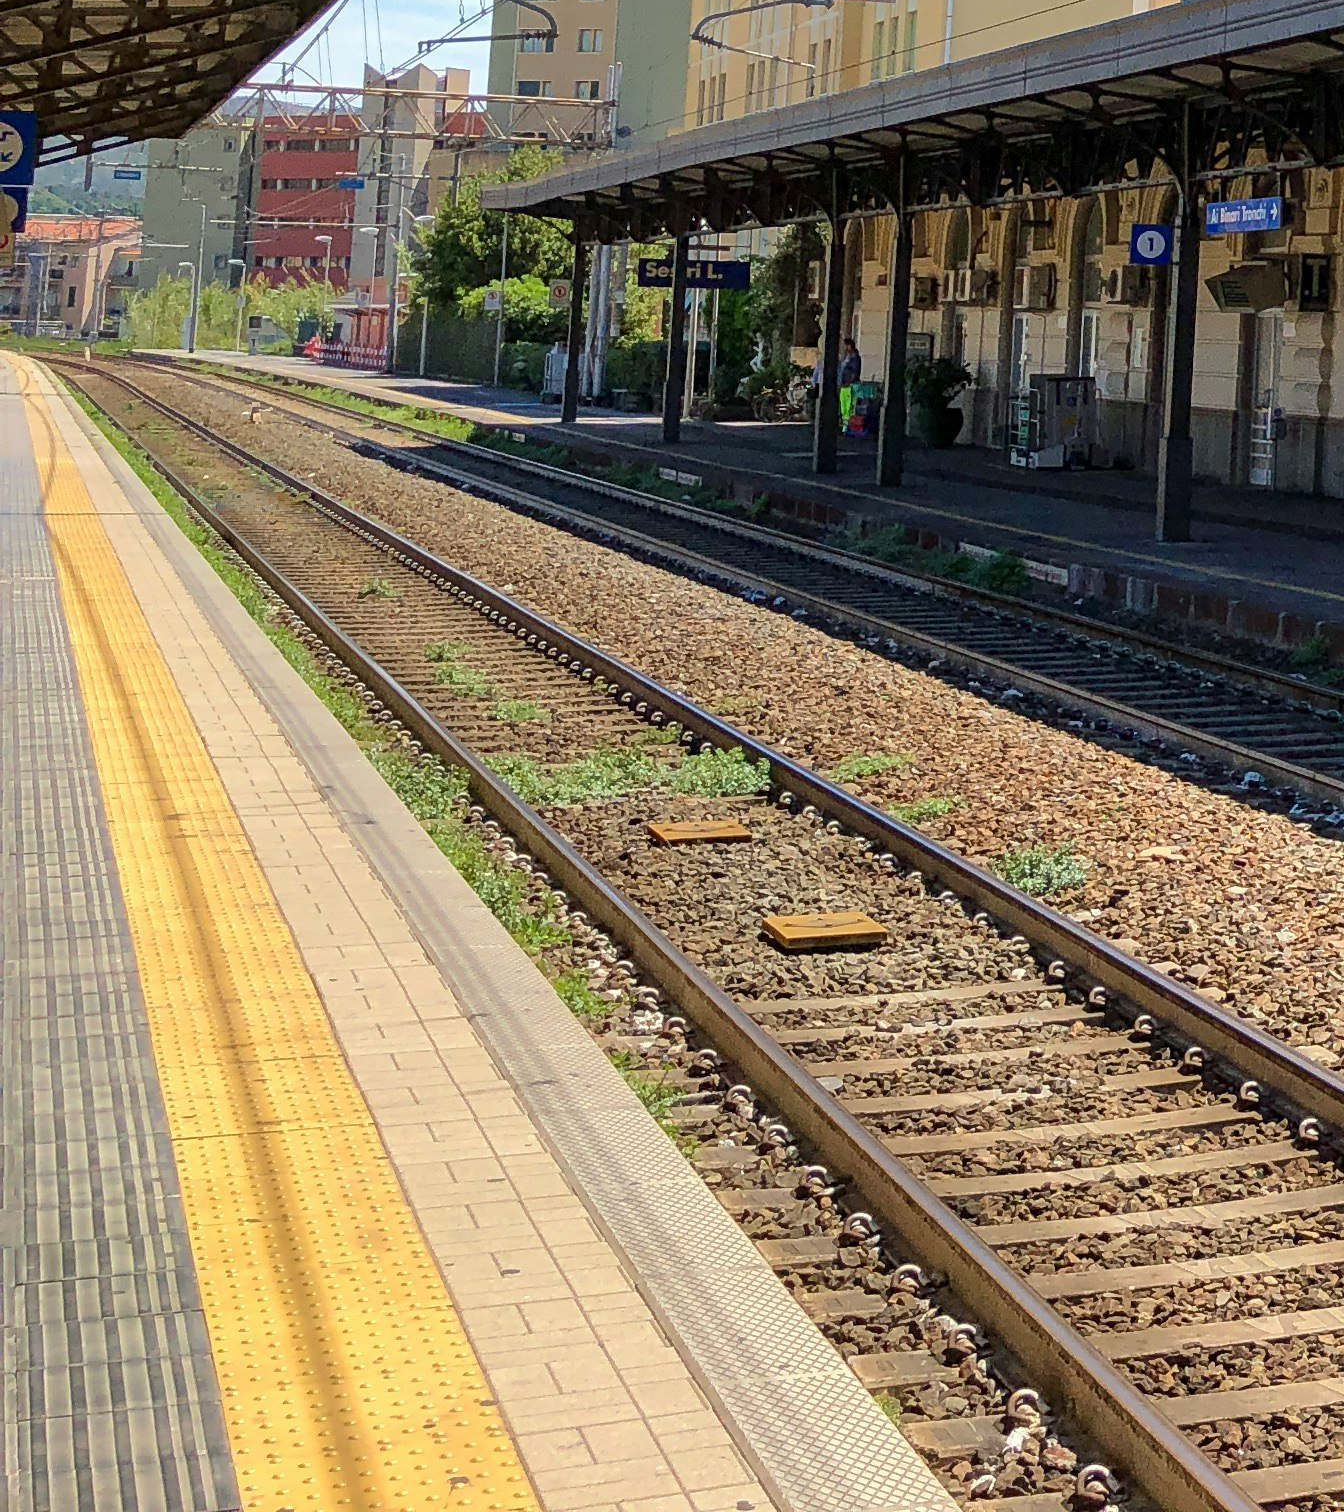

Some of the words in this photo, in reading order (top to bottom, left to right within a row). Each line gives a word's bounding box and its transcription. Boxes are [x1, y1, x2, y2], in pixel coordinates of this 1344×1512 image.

[1220, 206, 1241, 224] Binari
[1148, 238, 1154, 252] 1
[645, 261, 701, 279] Seri
[707, 262, 723, 279] L.
